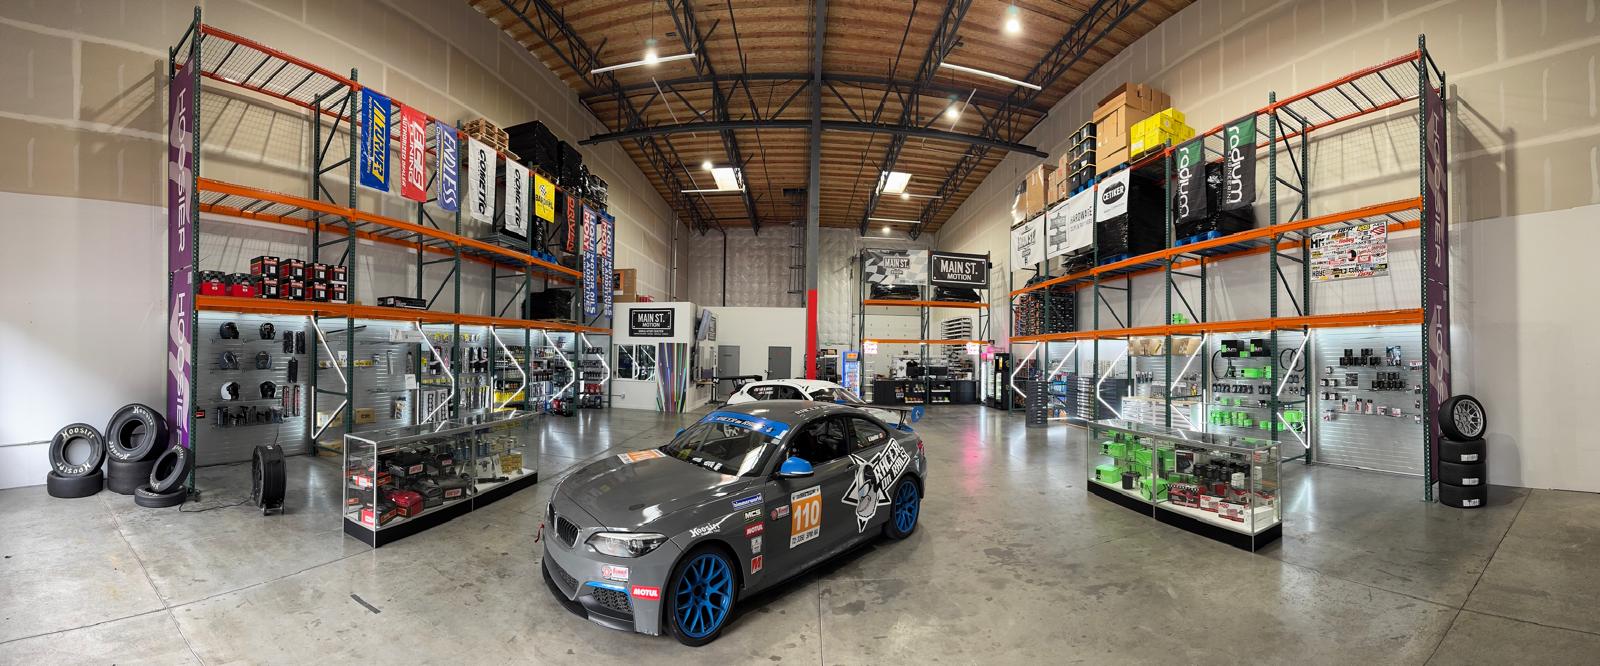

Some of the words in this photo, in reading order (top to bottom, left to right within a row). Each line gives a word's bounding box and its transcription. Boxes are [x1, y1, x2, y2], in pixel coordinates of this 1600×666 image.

[373, 120, 386, 178] TURNER
[412, 121, 424, 191] ECS
[178, 87, 187, 252] HOOSIER
[443, 131, 457, 208] ENDLESS
[1228, 126, 1245, 204] radium
[1180, 147, 1192, 218] radium
[1433, 112, 1441, 268] HOOSIER
[884, 258, 900, 268] MAIN
[940, 259, 963, 274] MAIN
[964, 262, 978, 275] ST.
[947, 273, 972, 281] MOTION
[637, 313, 655, 323] MAIN
[655, 313, 665, 323] ST.
[60, 427, 95, 441] Hoosier
[55, 462, 91, 475] Hoosier
[873, 441, 901, 484] RACER
[891, 449, 908, 477] RAILS
[794, 499, 820, 531] 110
[689, 521, 721, 538] Hoosier
[746, 524, 764, 536] MOTUL
[633, 588, 658, 597] MOTUL
